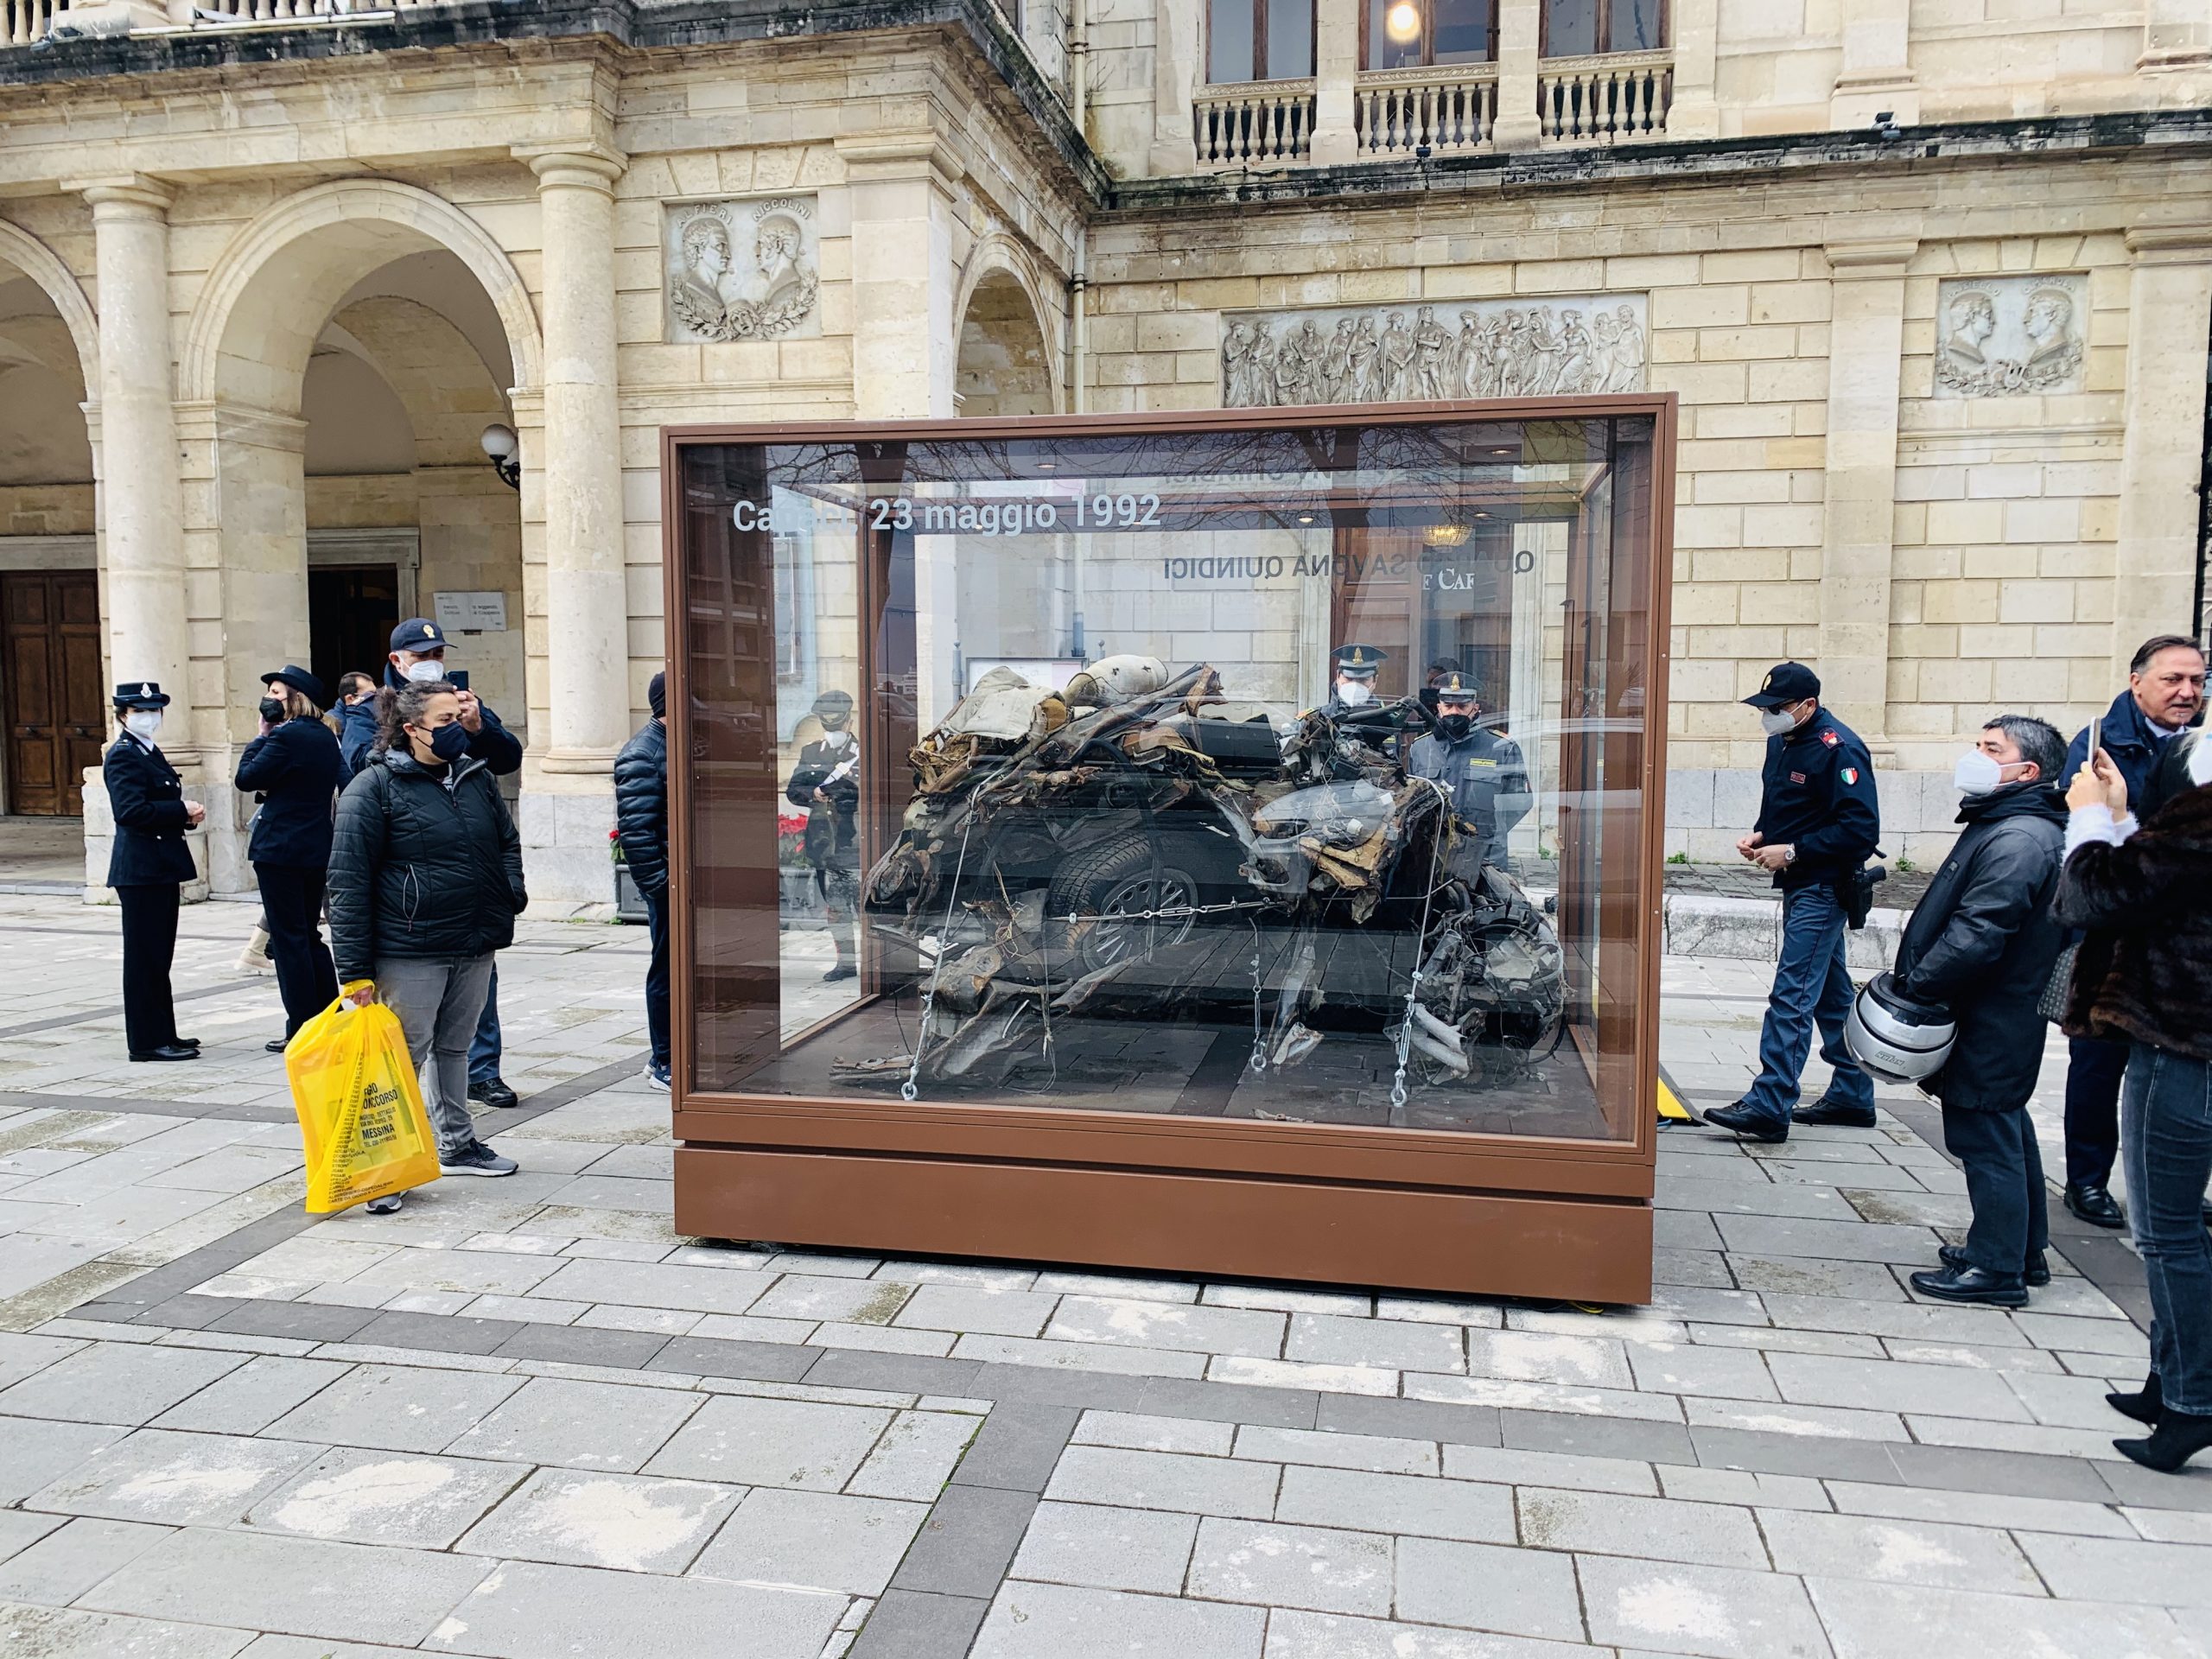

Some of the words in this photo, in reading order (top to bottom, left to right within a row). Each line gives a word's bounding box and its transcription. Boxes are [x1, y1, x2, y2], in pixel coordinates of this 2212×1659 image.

[676, 204, 733, 228] ALFIERI
[753, 199, 811, 222] NICCOLINI
[870, 499, 912, 531] 23
[925, 494, 1057, 537] maggio
[1071, 493, 1161, 527] 1992
[362, 1123, 395, 1140] MESSINA
